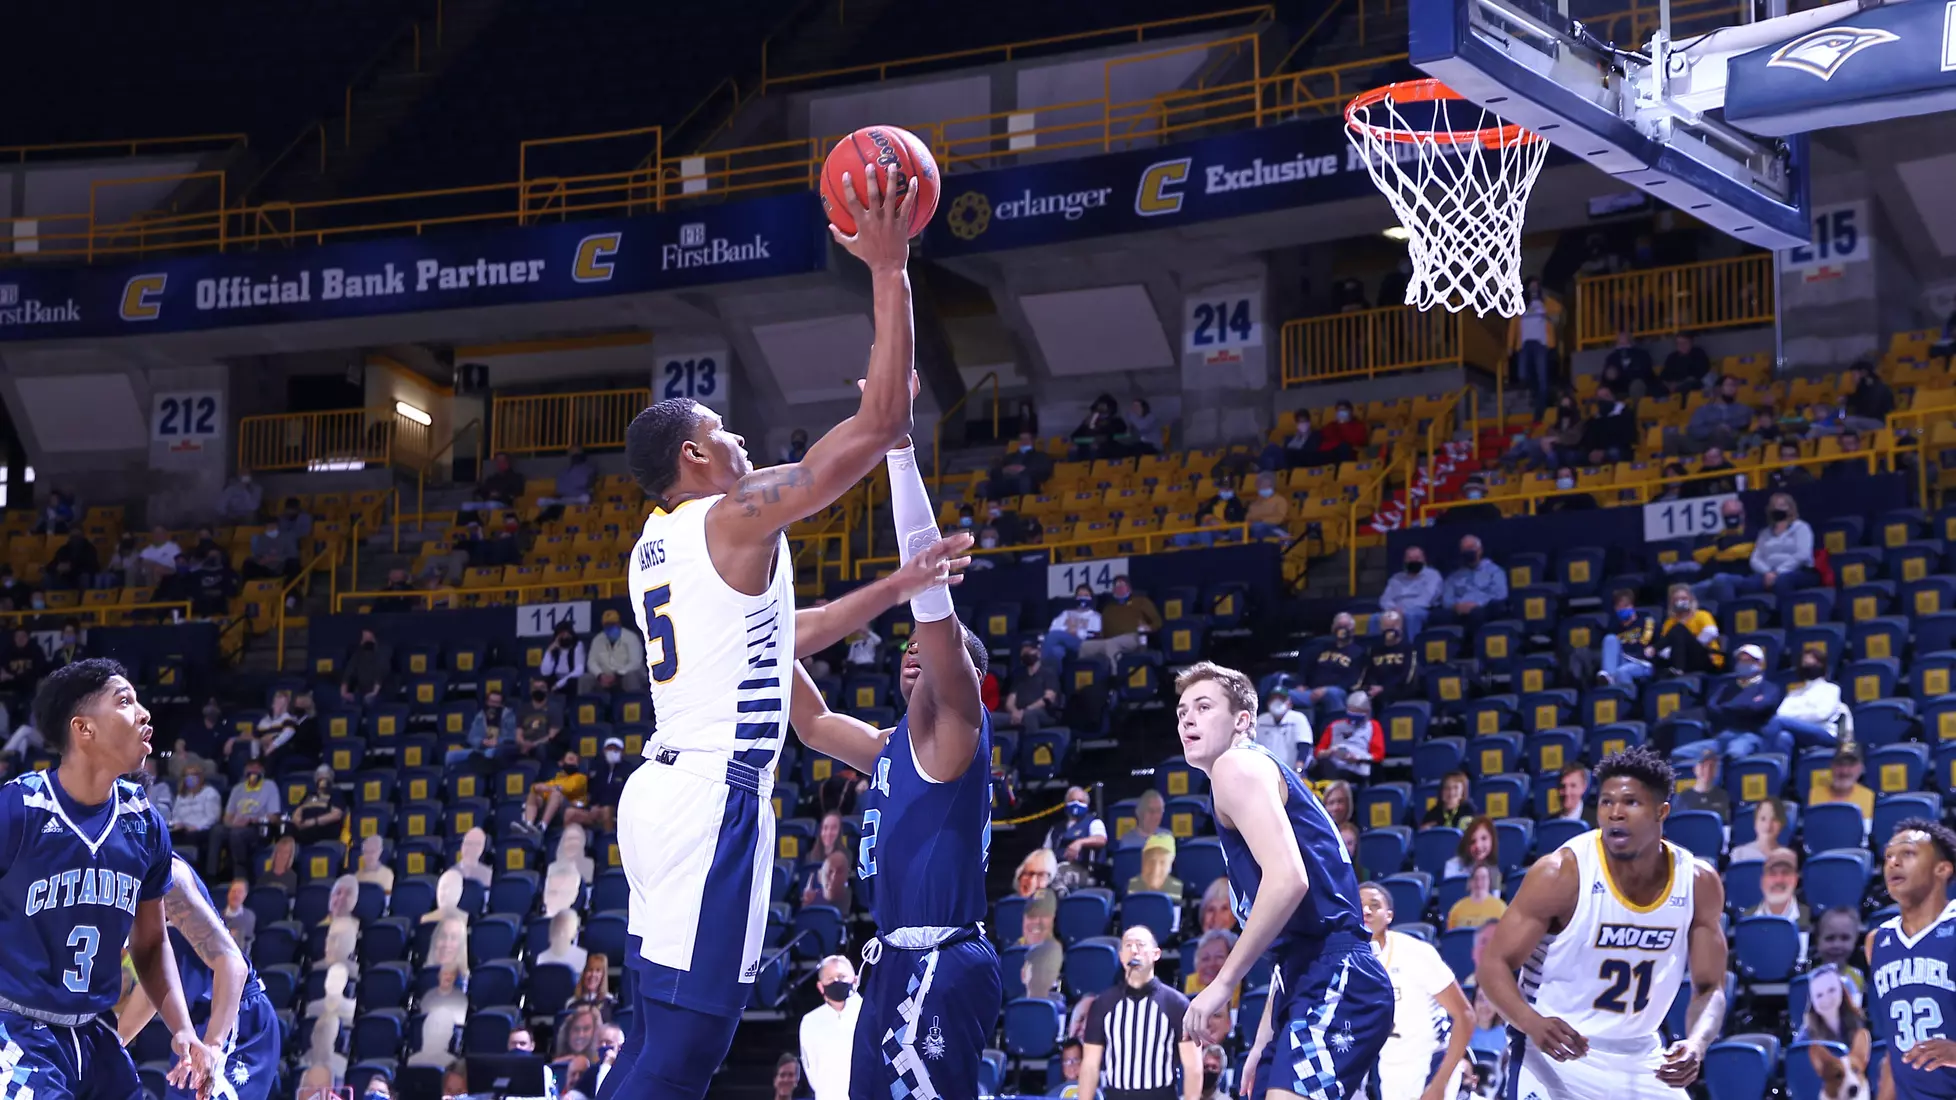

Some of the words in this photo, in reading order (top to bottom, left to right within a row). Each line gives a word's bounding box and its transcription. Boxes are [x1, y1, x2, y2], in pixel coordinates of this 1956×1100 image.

[1205, 153, 1338, 194] Exclusive
[995, 187, 1112, 221] erlanger
[662, 234, 771, 271] FirstBank
[196, 271, 311, 310] Official
[322, 262, 405, 300] Bank
[416, 258, 546, 292] Partner
[0, 298, 81, 325] rstBank
[1193, 299, 1252, 346] 214
[665, 357, 717, 399] 213
[159, 396, 217, 435] 212
[1661, 501, 1719, 534] 115
[637, 539, 666, 572] ANKS
[1063, 563, 1113, 593] 114
[643, 580, 681, 685] 5
[41, 826, 64, 834] adidas
[1597, 925, 1675, 949] MOCS
[63, 925, 101, 993] 3
[1873, 956, 1956, 999] CITADEL
[1593, 958, 1657, 1015] 21
[1889, 996, 1947, 1053] 32
